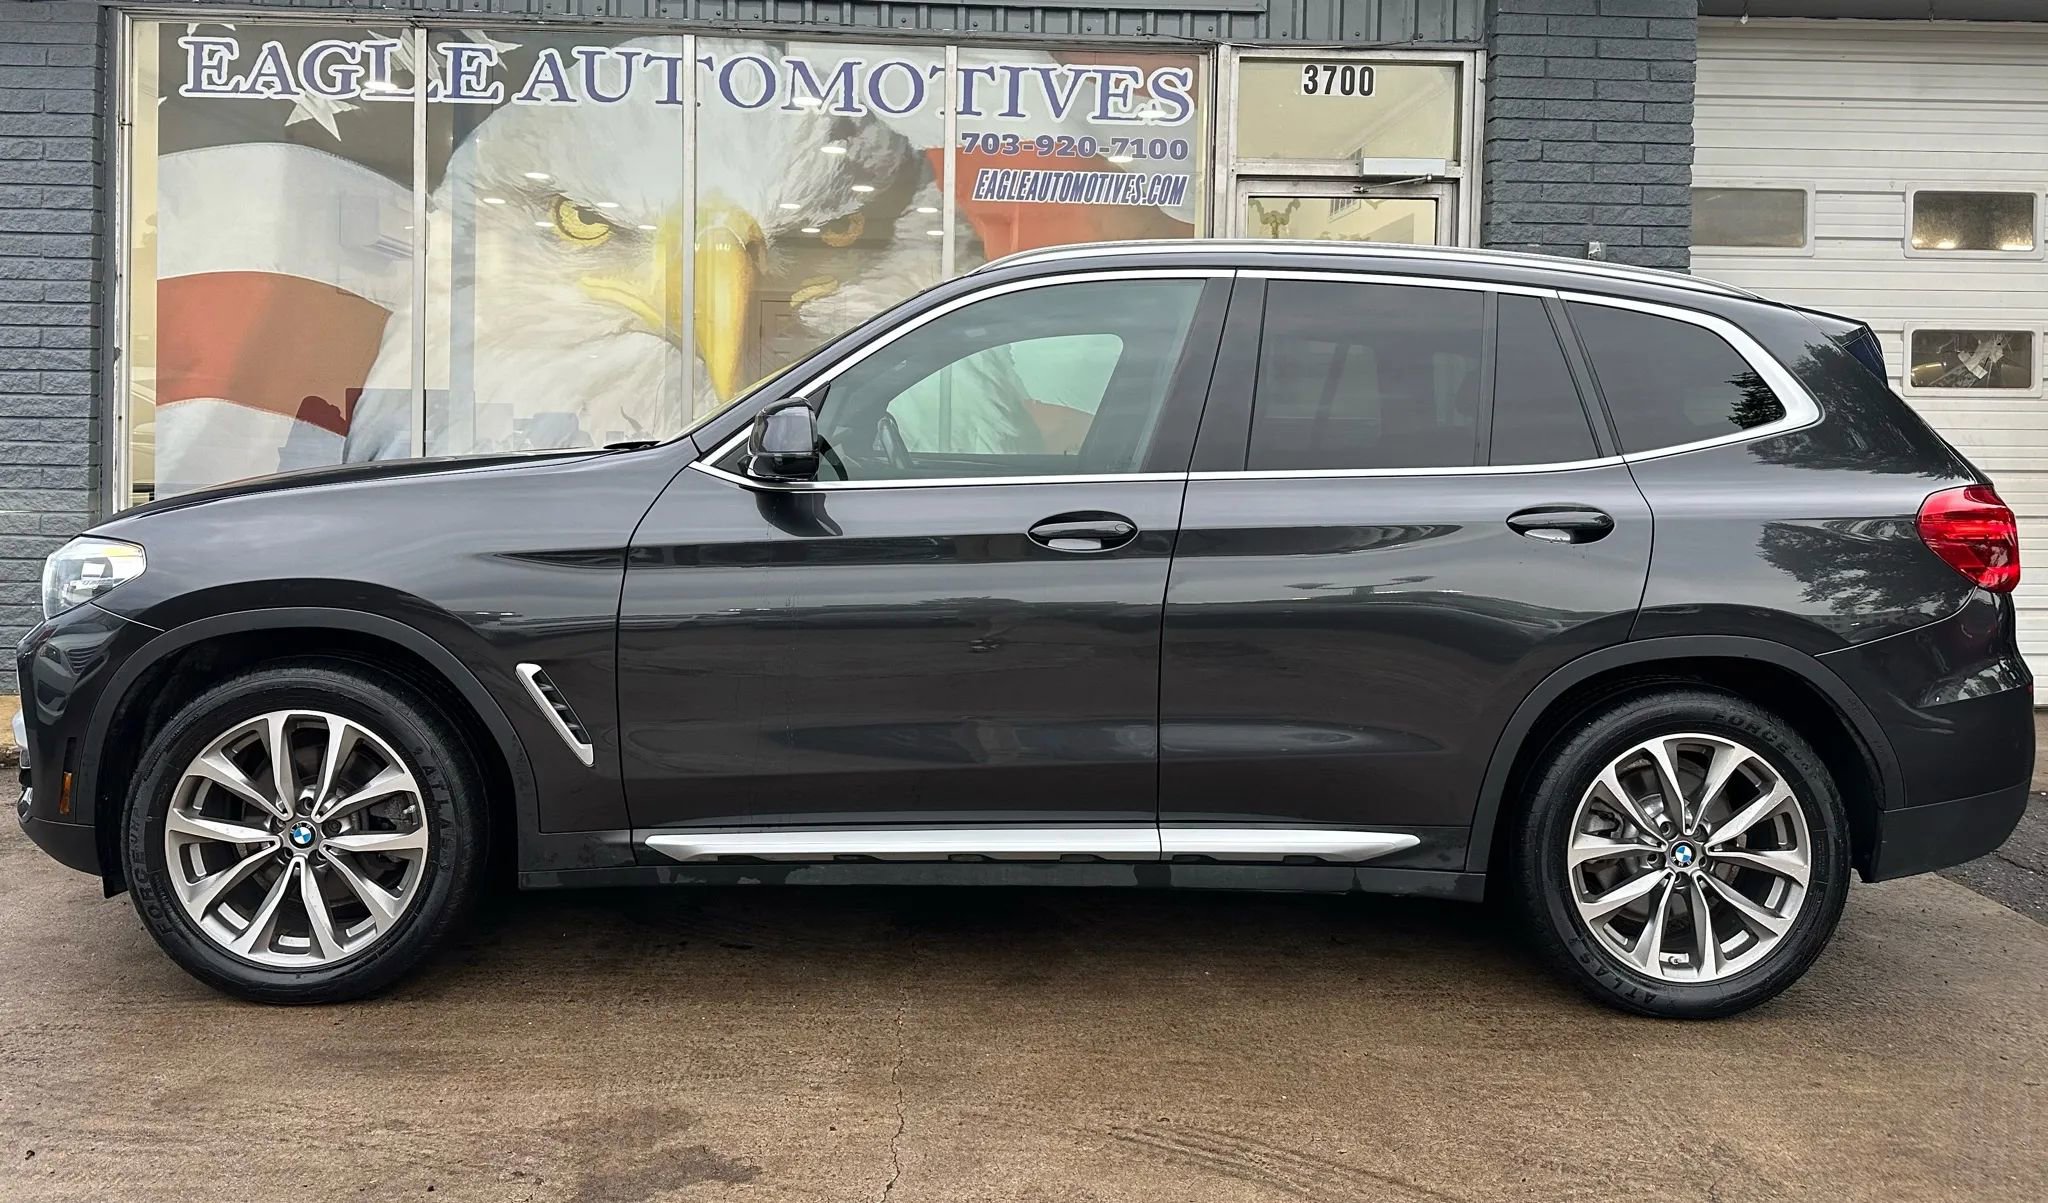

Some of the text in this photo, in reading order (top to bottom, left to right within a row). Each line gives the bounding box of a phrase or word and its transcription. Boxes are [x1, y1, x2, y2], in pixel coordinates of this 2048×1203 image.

[180, 37, 1195, 126] EAGLE AUTOMOTIVES
[1303, 64, 1374, 96] 3700
[961, 132, 1189, 161] 703-920-7100
[972, 168, 1189, 207] EAGLEAUTOMOTIVES.COM
[130, 849, 173, 934] FORCE
